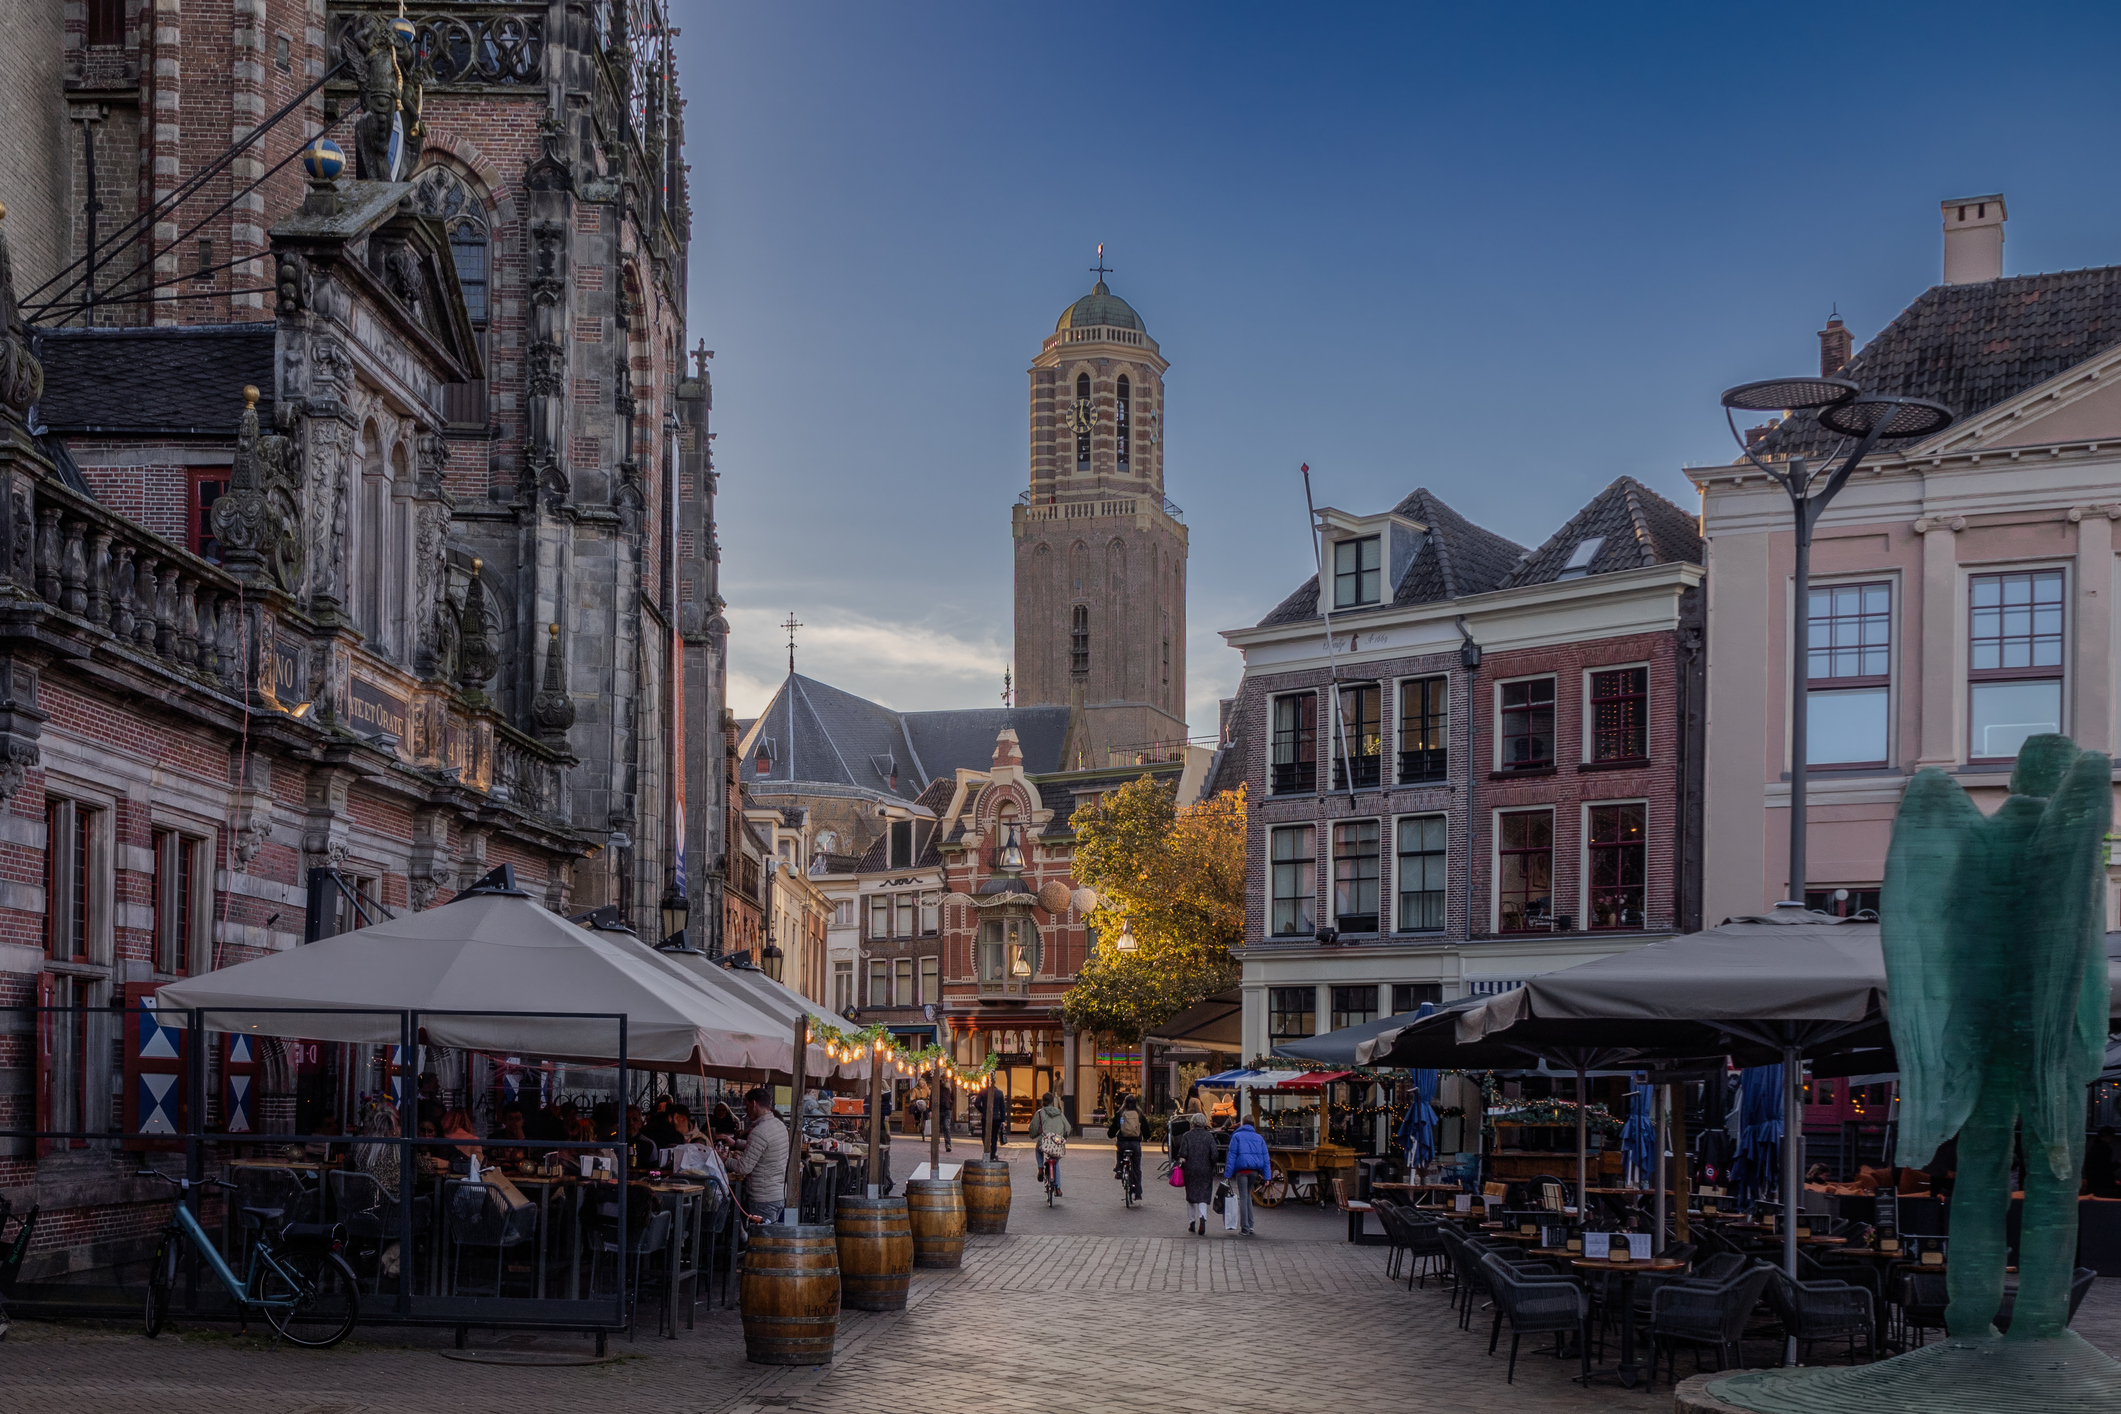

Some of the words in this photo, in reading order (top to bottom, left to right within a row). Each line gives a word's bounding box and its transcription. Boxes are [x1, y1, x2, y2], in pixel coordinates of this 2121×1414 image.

[276, 652, 293, 688] NO
[364, 701, 375, 723] ET
[376, 703, 403, 736] ORATE
[447, 741, 454, 761] 4
